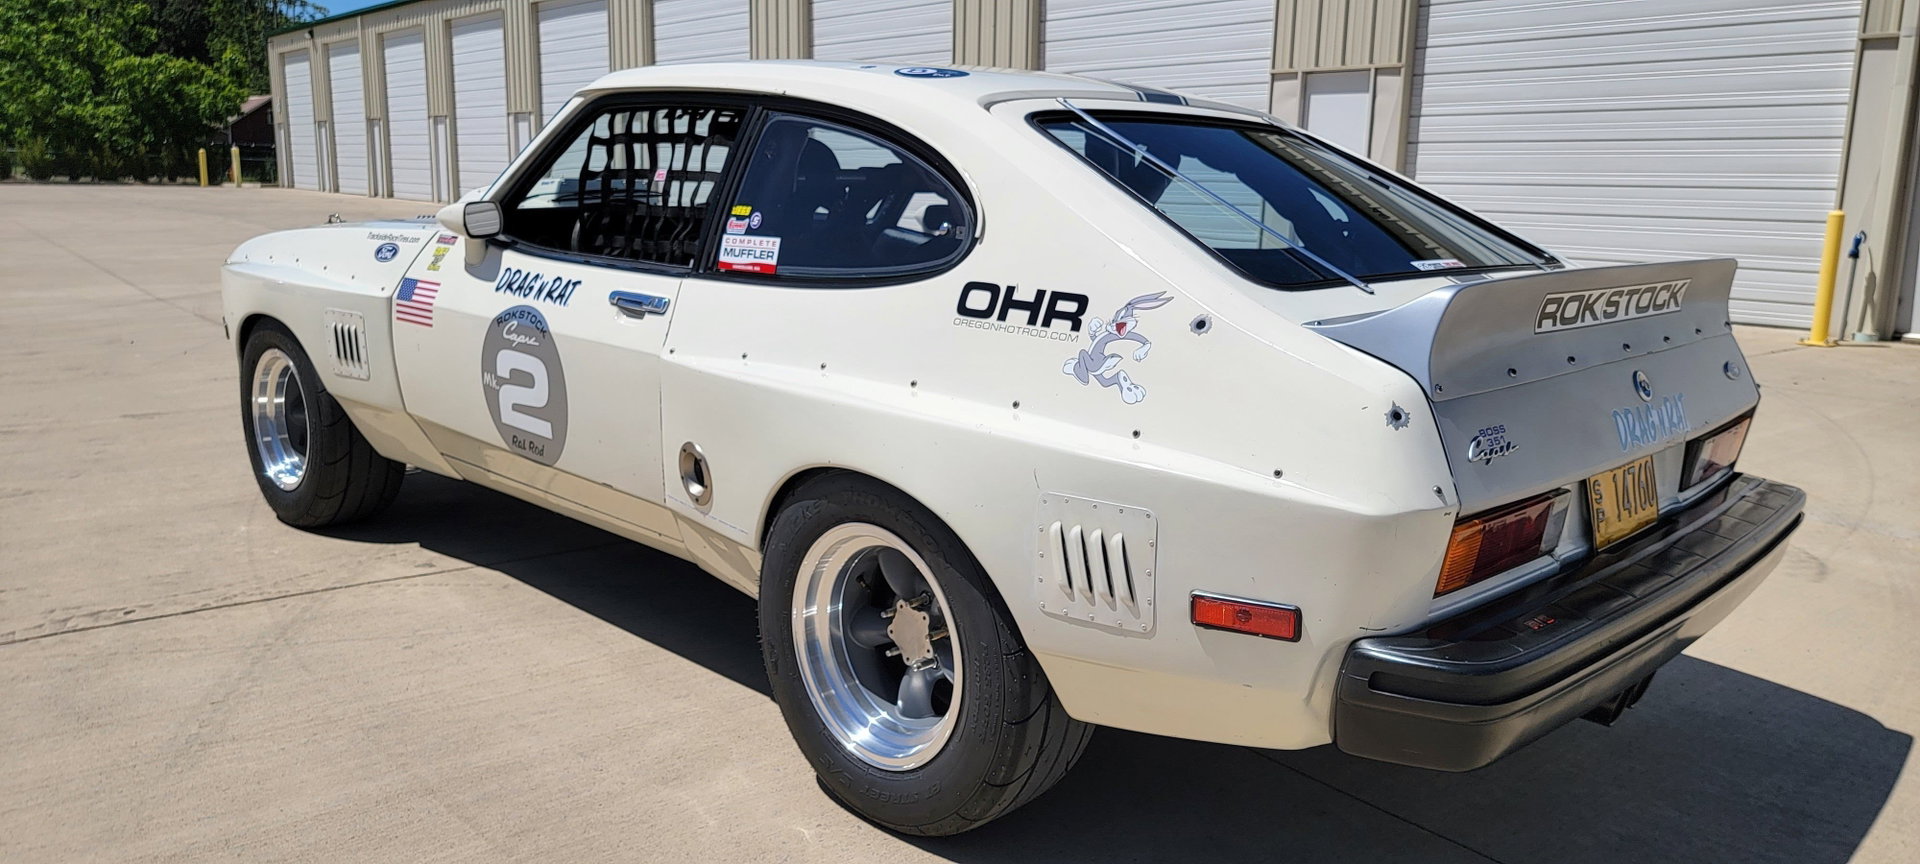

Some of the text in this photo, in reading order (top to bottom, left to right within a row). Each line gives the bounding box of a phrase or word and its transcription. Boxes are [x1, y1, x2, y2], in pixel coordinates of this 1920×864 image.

[377, 245, 396, 260] Ford
[723, 248, 775, 260] MUFFLER
[725, 237, 777, 247] COMPLETE
[956, 281, 1090, 333] OHR
[1537, 281, 1688, 329] ROKSTOCK
[496, 310, 547, 339] ROKSTOCK
[503, 320, 540, 348] Capri
[953, 317, 1080, 343] OREGONHOTROD.COM
[496, 349, 553, 440] 2
[1479, 424, 1506, 438] BOSS
[1487, 435, 1506, 448] 351
[512, 435, 545, 457] Rat Rod
[1612, 460, 1655, 522] 14760
